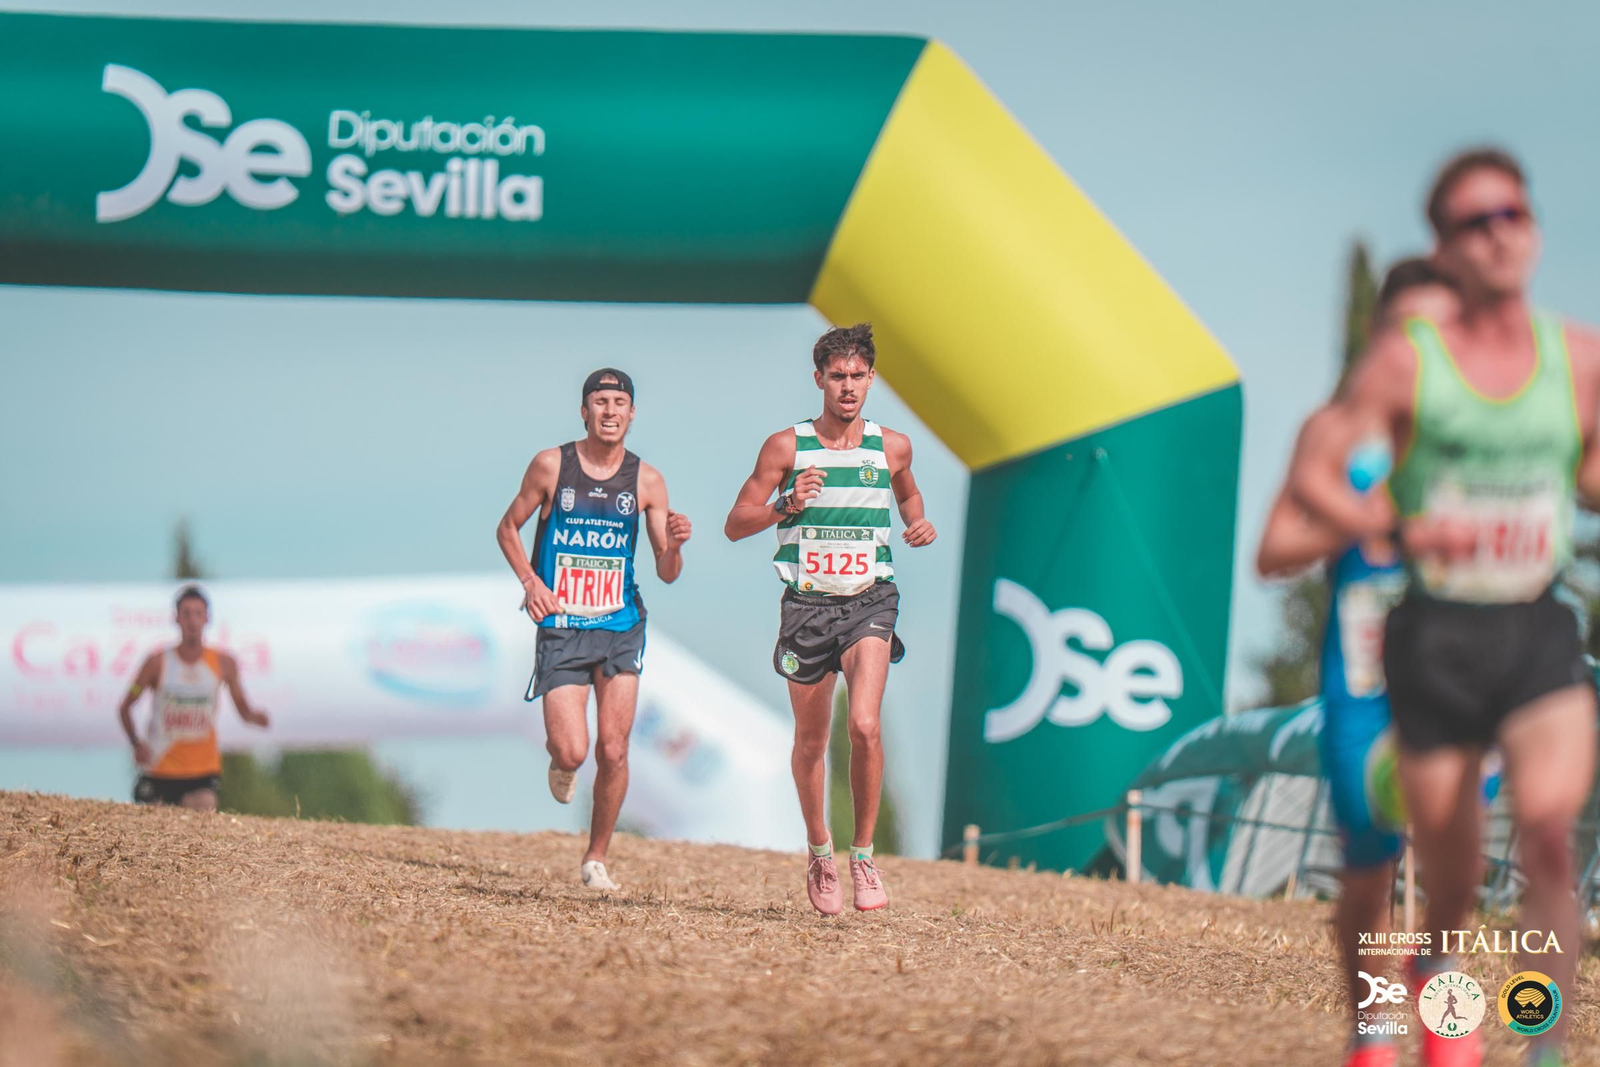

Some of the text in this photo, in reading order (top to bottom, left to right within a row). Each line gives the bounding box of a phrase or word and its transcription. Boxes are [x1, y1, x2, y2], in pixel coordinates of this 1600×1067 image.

[327, 109, 546, 158] Diputación
[325, 153, 544, 222] Sevilla
[565, 517, 624, 529] CLUB ATLETISMO
[821, 529, 857, 539] ITÁLICA
[552, 528, 629, 550] NARÓN
[576, 558, 609, 568] ITÁLICA
[805, 552, 869, 576] 5125
[556, 567, 622, 607] ATRIKI
[582, 614, 613, 627] GALICIA
